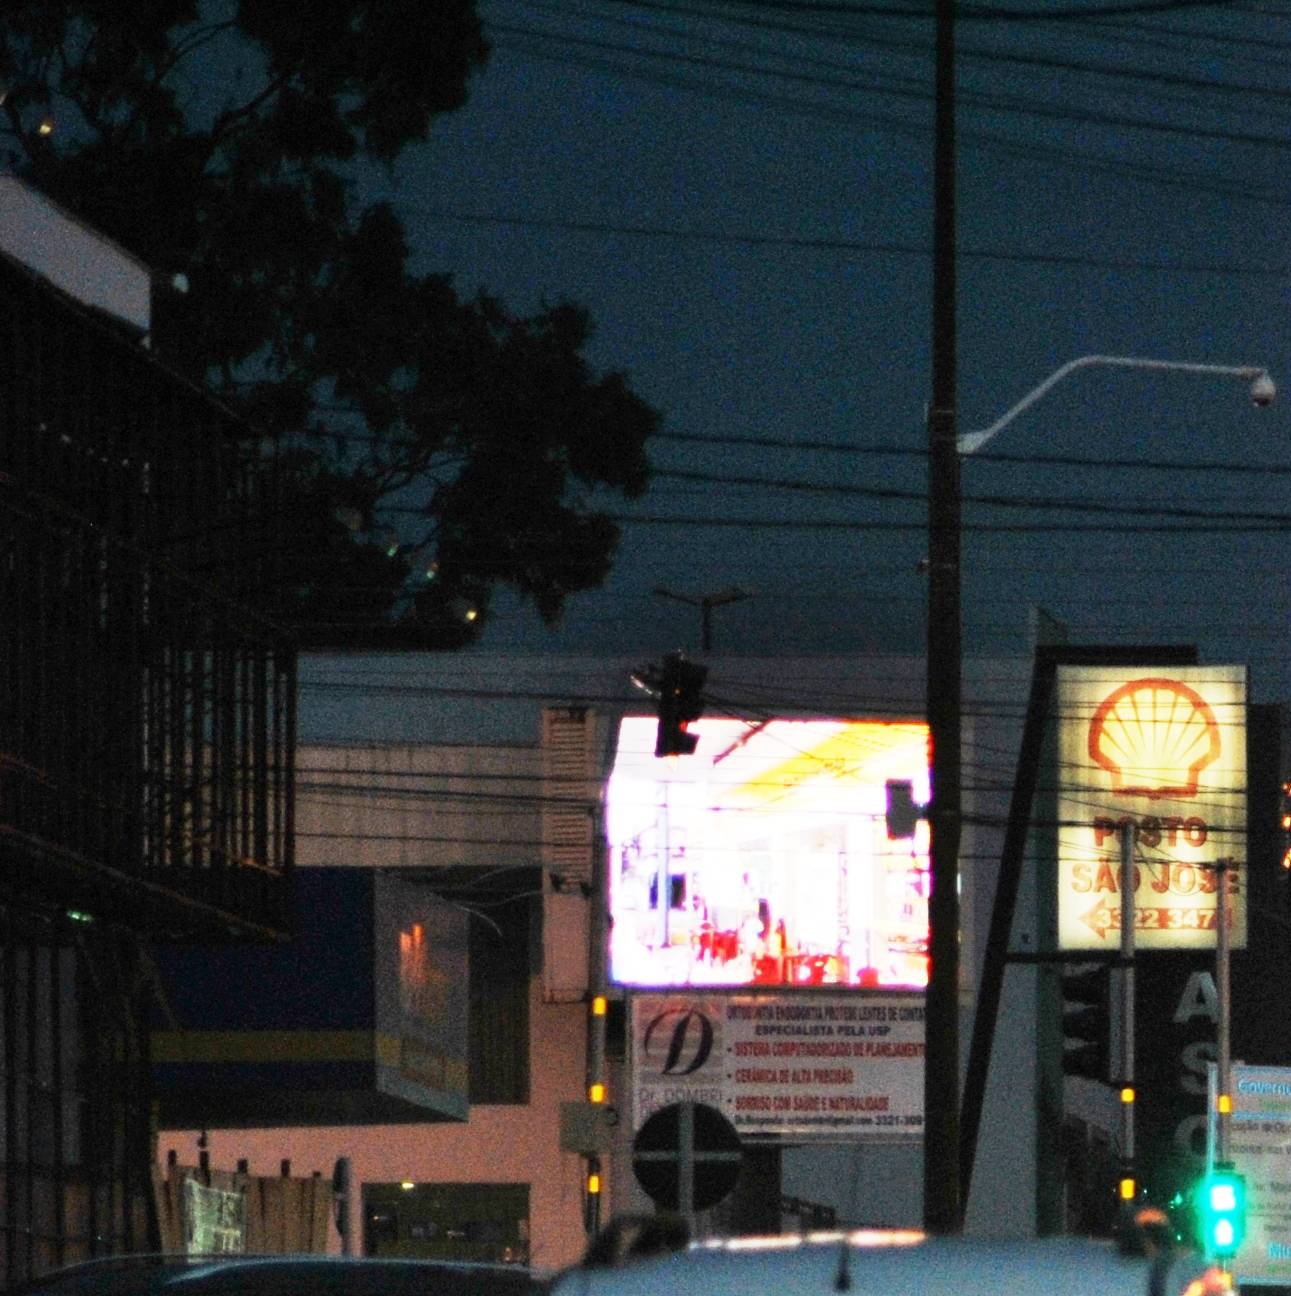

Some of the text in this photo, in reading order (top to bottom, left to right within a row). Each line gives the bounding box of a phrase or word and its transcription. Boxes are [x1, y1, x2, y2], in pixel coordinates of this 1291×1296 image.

[1094, 815, 1207, 848] POSTO
[1167, 907, 1217, 929] 347
[755, 1025, 892, 1036] ESPECIALISTA PELA USP
